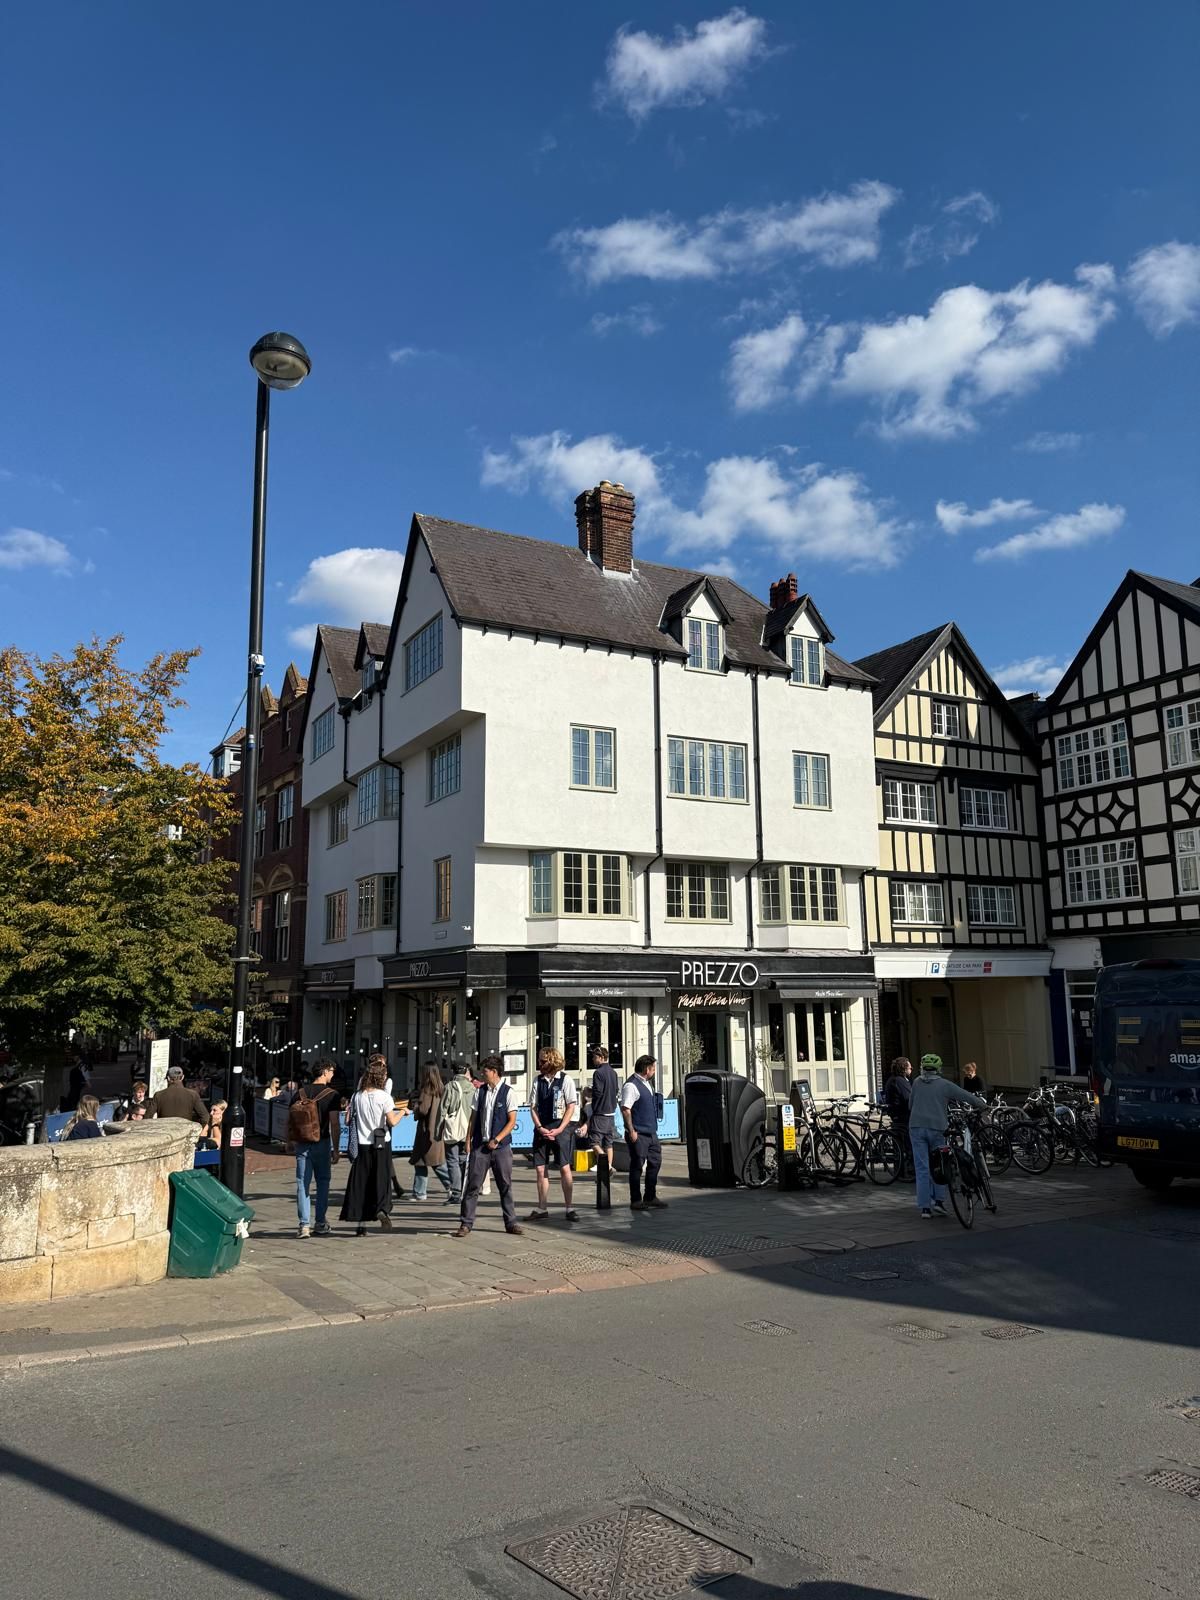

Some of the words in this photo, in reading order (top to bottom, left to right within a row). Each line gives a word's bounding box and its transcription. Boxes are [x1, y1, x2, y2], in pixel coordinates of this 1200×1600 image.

[682, 961, 759, 986] PREZZO
[678, 993, 703, 1008] Pasta
[704, 992, 728, 1006] Pizza
[728, 992, 751, 1005] Vino
